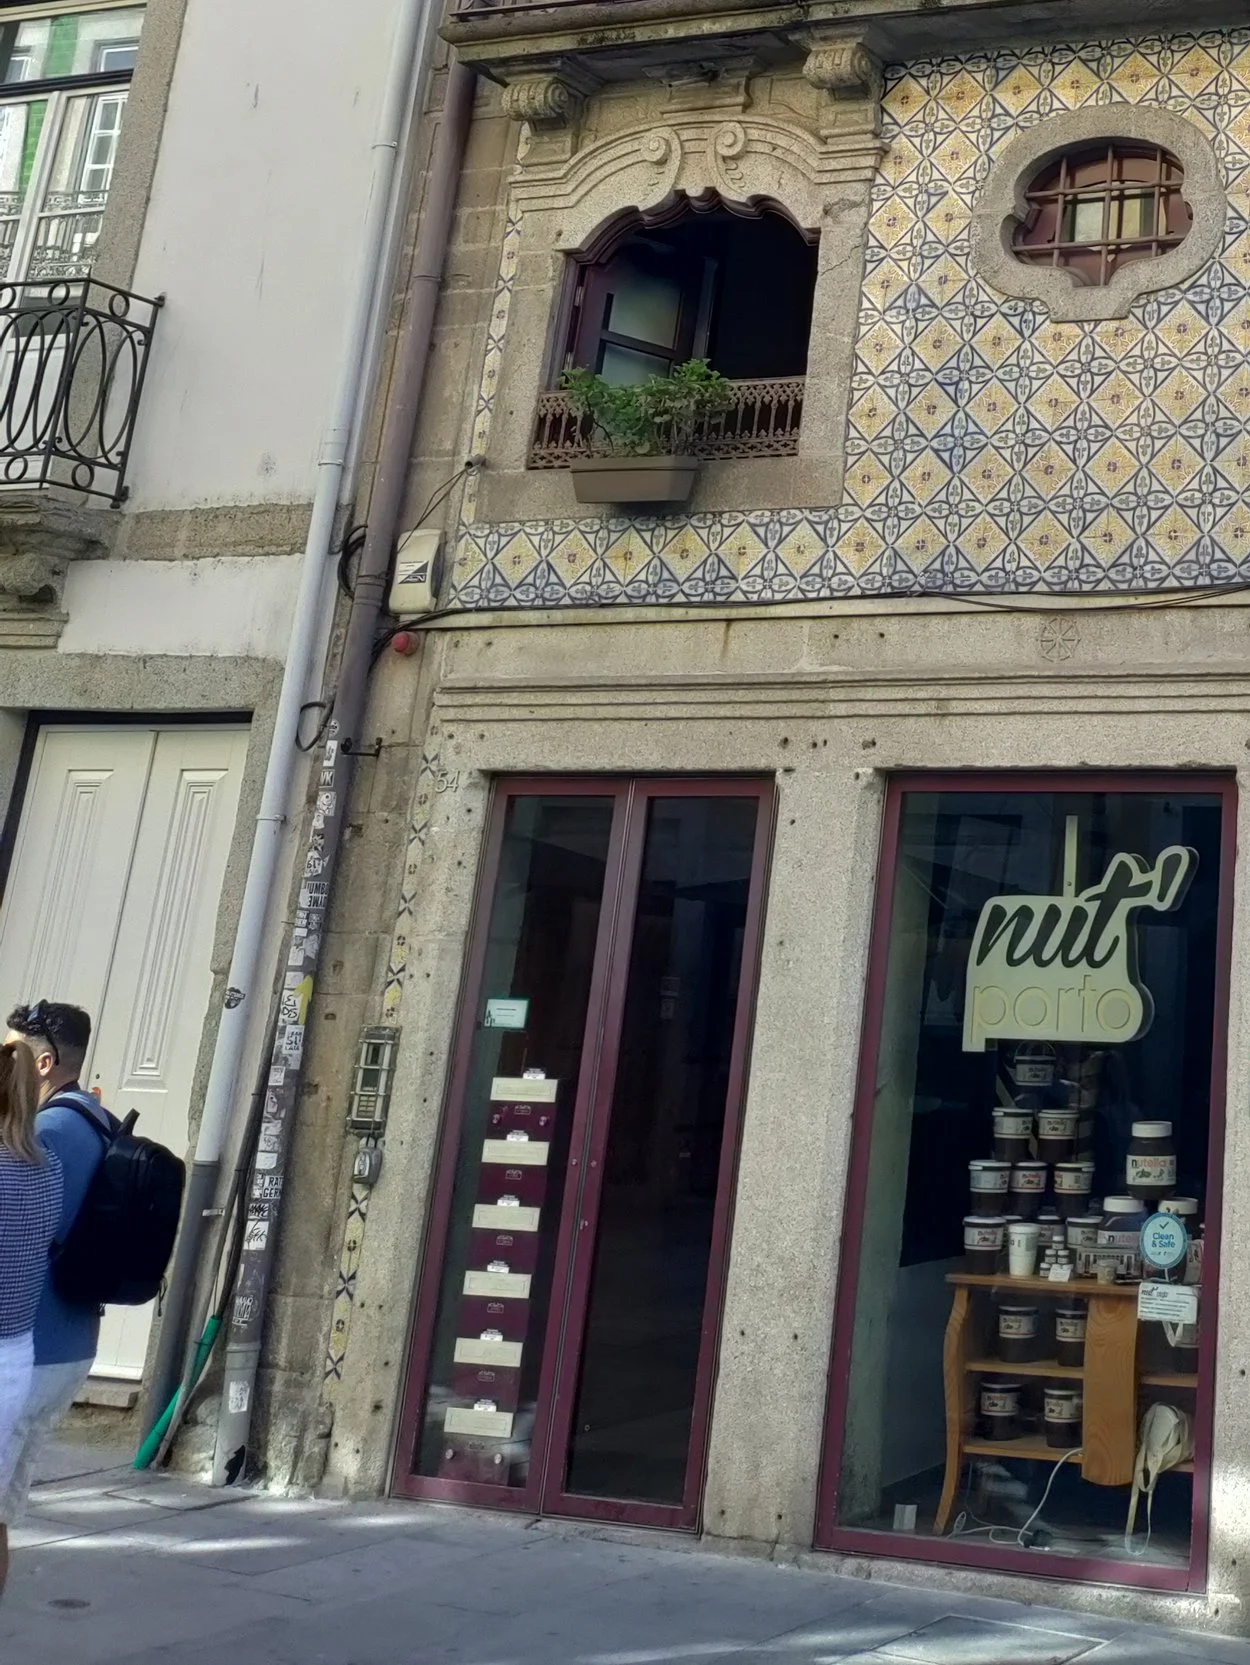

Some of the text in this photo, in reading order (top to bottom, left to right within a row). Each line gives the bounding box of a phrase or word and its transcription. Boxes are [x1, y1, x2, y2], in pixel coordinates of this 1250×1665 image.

[436, 769, 460, 793] 54
[970, 974, 1134, 1043] porto
[1152, 1232, 1175, 1241] Clean
[1158, 1239, 1176, 1248] Safe
